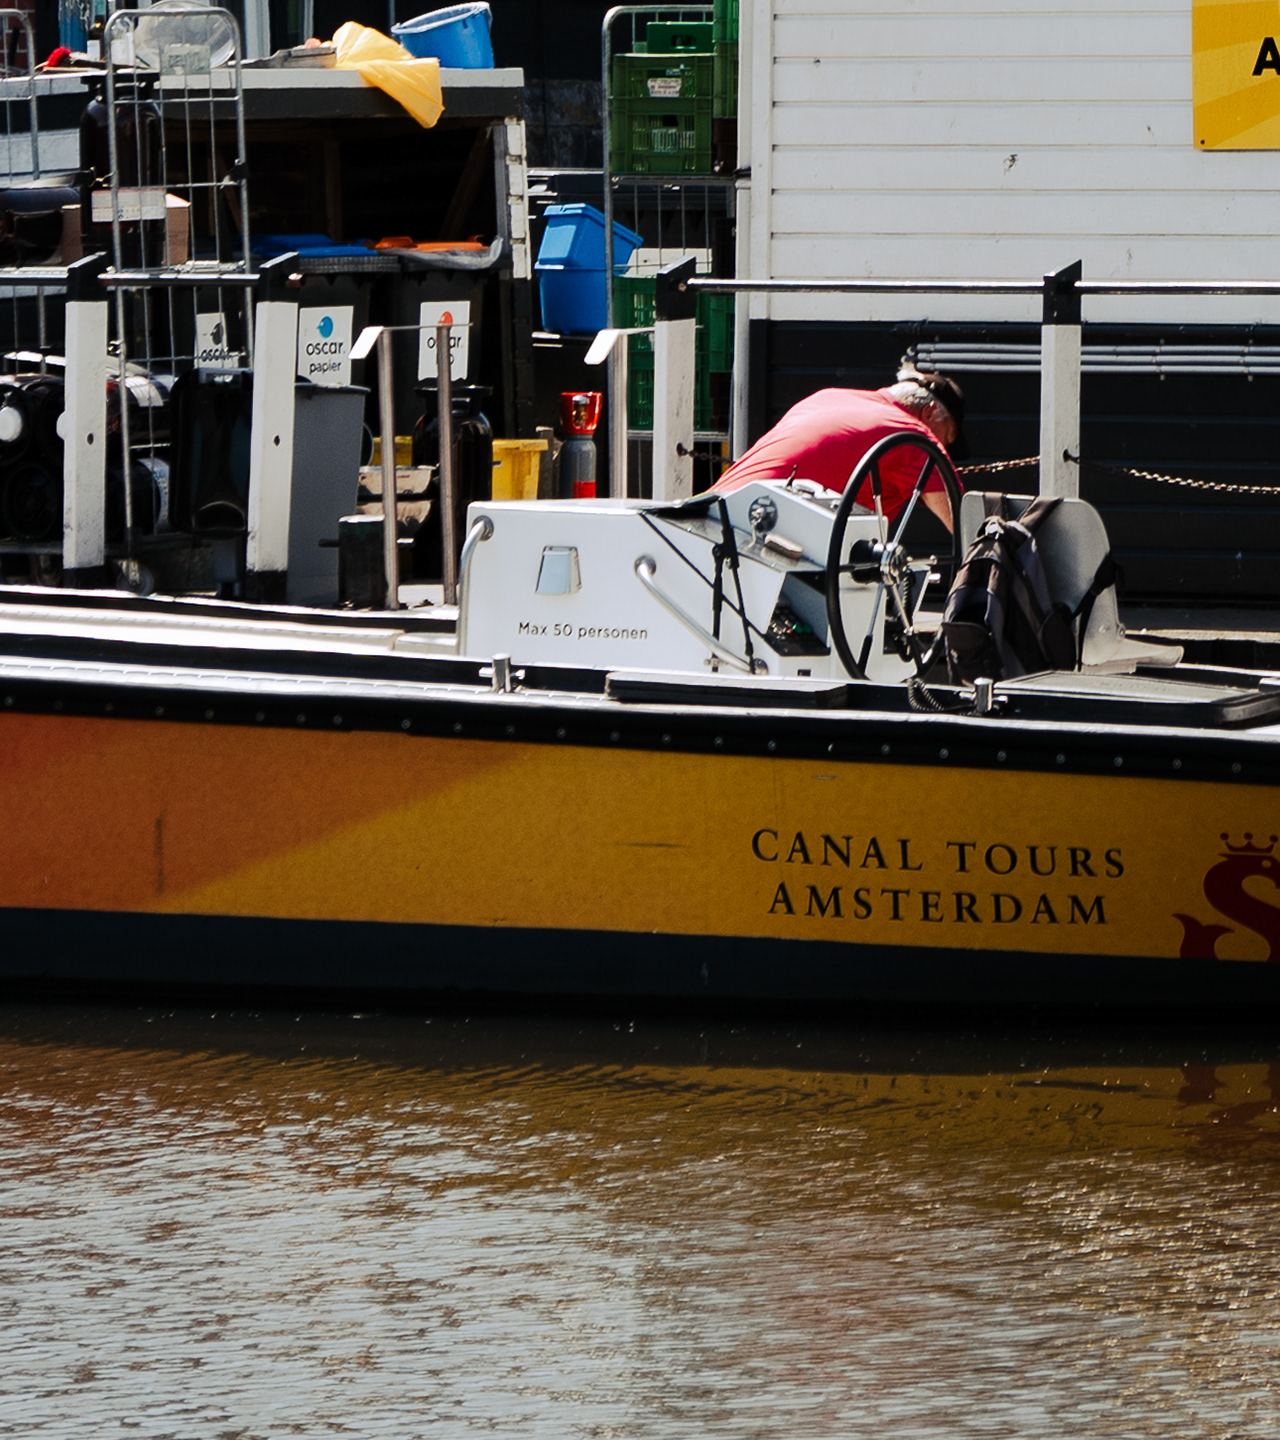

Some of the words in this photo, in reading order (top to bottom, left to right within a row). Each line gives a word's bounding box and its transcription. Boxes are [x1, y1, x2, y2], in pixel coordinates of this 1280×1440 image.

[426, 336, 462, 349] oar
[309, 360, 342, 376] papier
[518, 622, 547, 636] Max
[553, 623, 573, 637] 50
[578, 627, 648, 640] personen
[751, 829, 923, 871] CANAL
[946, 841, 1125, 878] TOURS
[767, 882, 1108, 925] AMSTERDAM
